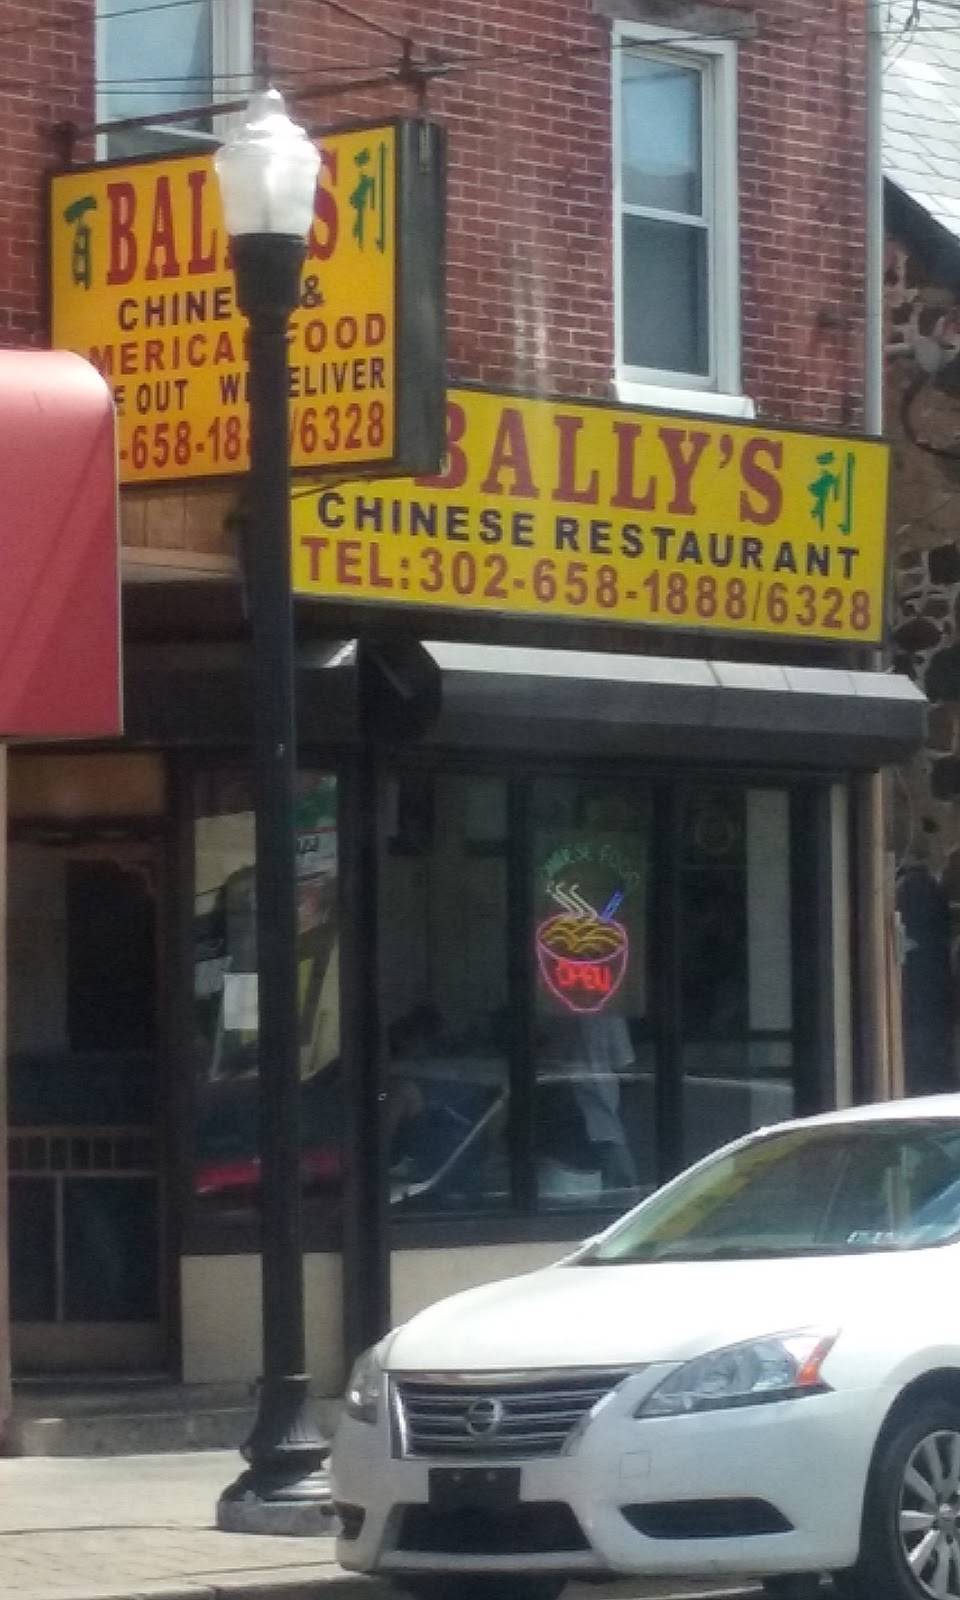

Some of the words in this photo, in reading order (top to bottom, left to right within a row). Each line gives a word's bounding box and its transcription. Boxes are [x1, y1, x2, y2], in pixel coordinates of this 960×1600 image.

[106, 150, 338, 285] BALS
[118, 286, 232, 331] CHINE
[303, 275, 323, 308] &
[89, 331, 251, 376] MERICA
[136, 379, 188, 415] OUT
[219, 371, 252, 406] W
[288, 357, 386, 399] ELIVER
[414, 402, 783, 526] BALLY'S
[317, 492, 535, 549] CHINESE
[555, 515, 860, 580] RESTAURANT
[557, 958, 612, 993] OPEN
